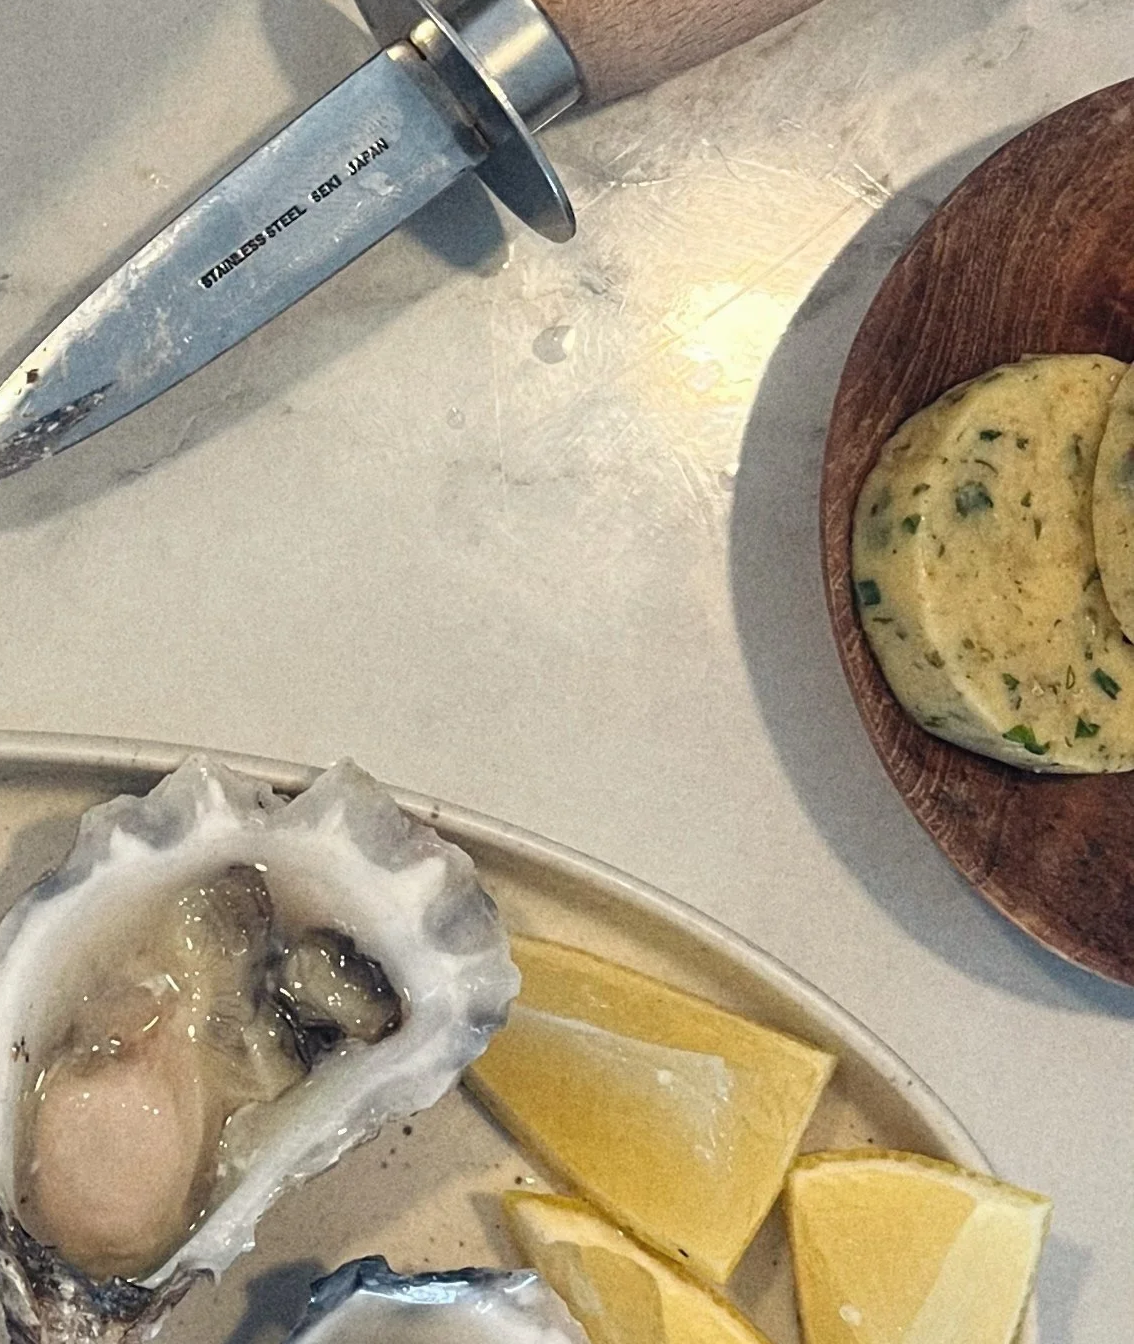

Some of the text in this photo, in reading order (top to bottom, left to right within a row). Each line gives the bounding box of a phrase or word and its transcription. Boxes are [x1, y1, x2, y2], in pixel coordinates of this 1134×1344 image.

[200, 137, 390, 289] STAINLESS STEEL SEKI JAPAN
